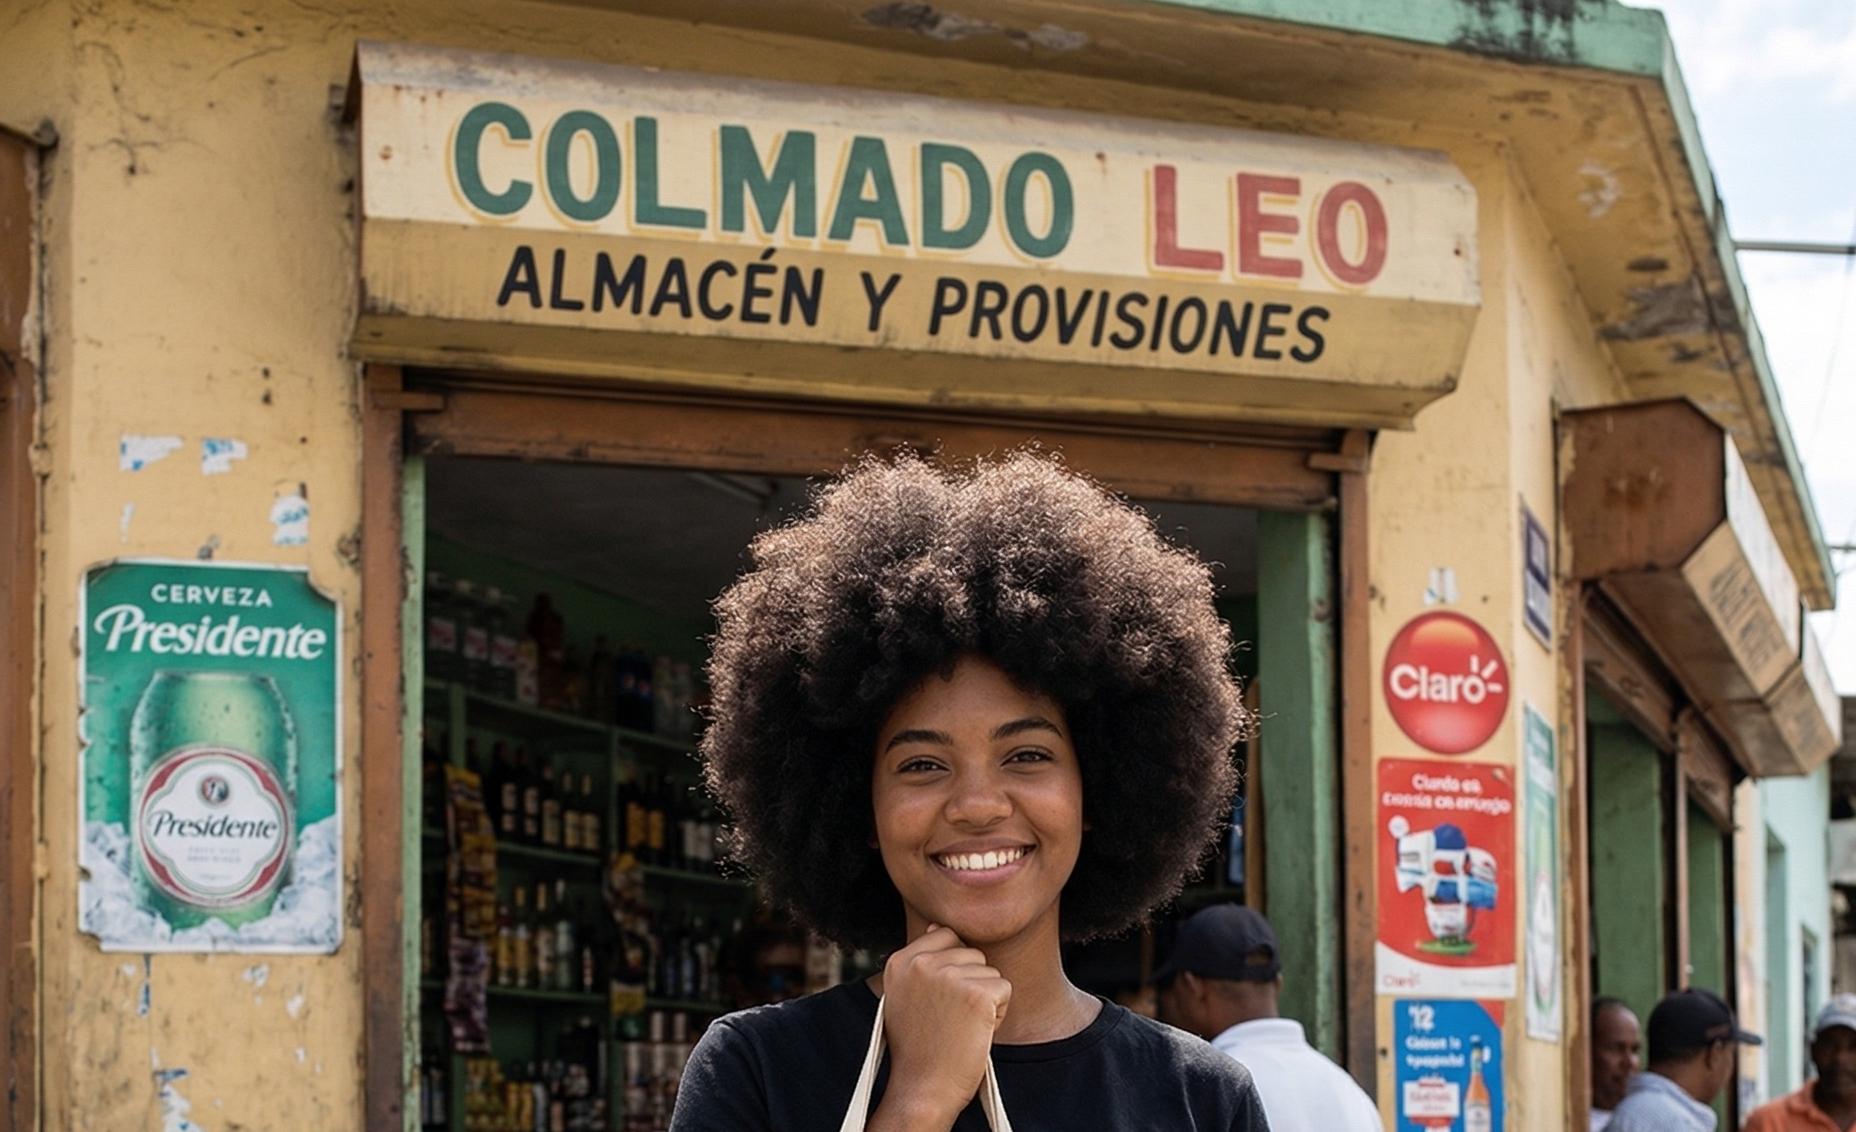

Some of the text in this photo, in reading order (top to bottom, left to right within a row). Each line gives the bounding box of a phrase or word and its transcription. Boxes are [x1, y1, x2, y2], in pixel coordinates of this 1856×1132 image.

[452, 102, 1389, 285] COLMADO LEO
[496, 245, 1331, 363] ALMACÉN Y PROVISIONES
[150, 583, 273, 607] CERVEZA
[94, 603, 327, 660] Presidente
[1389, 663, 1487, 704] Claro
[148, 808, 278, 839] Presidente
